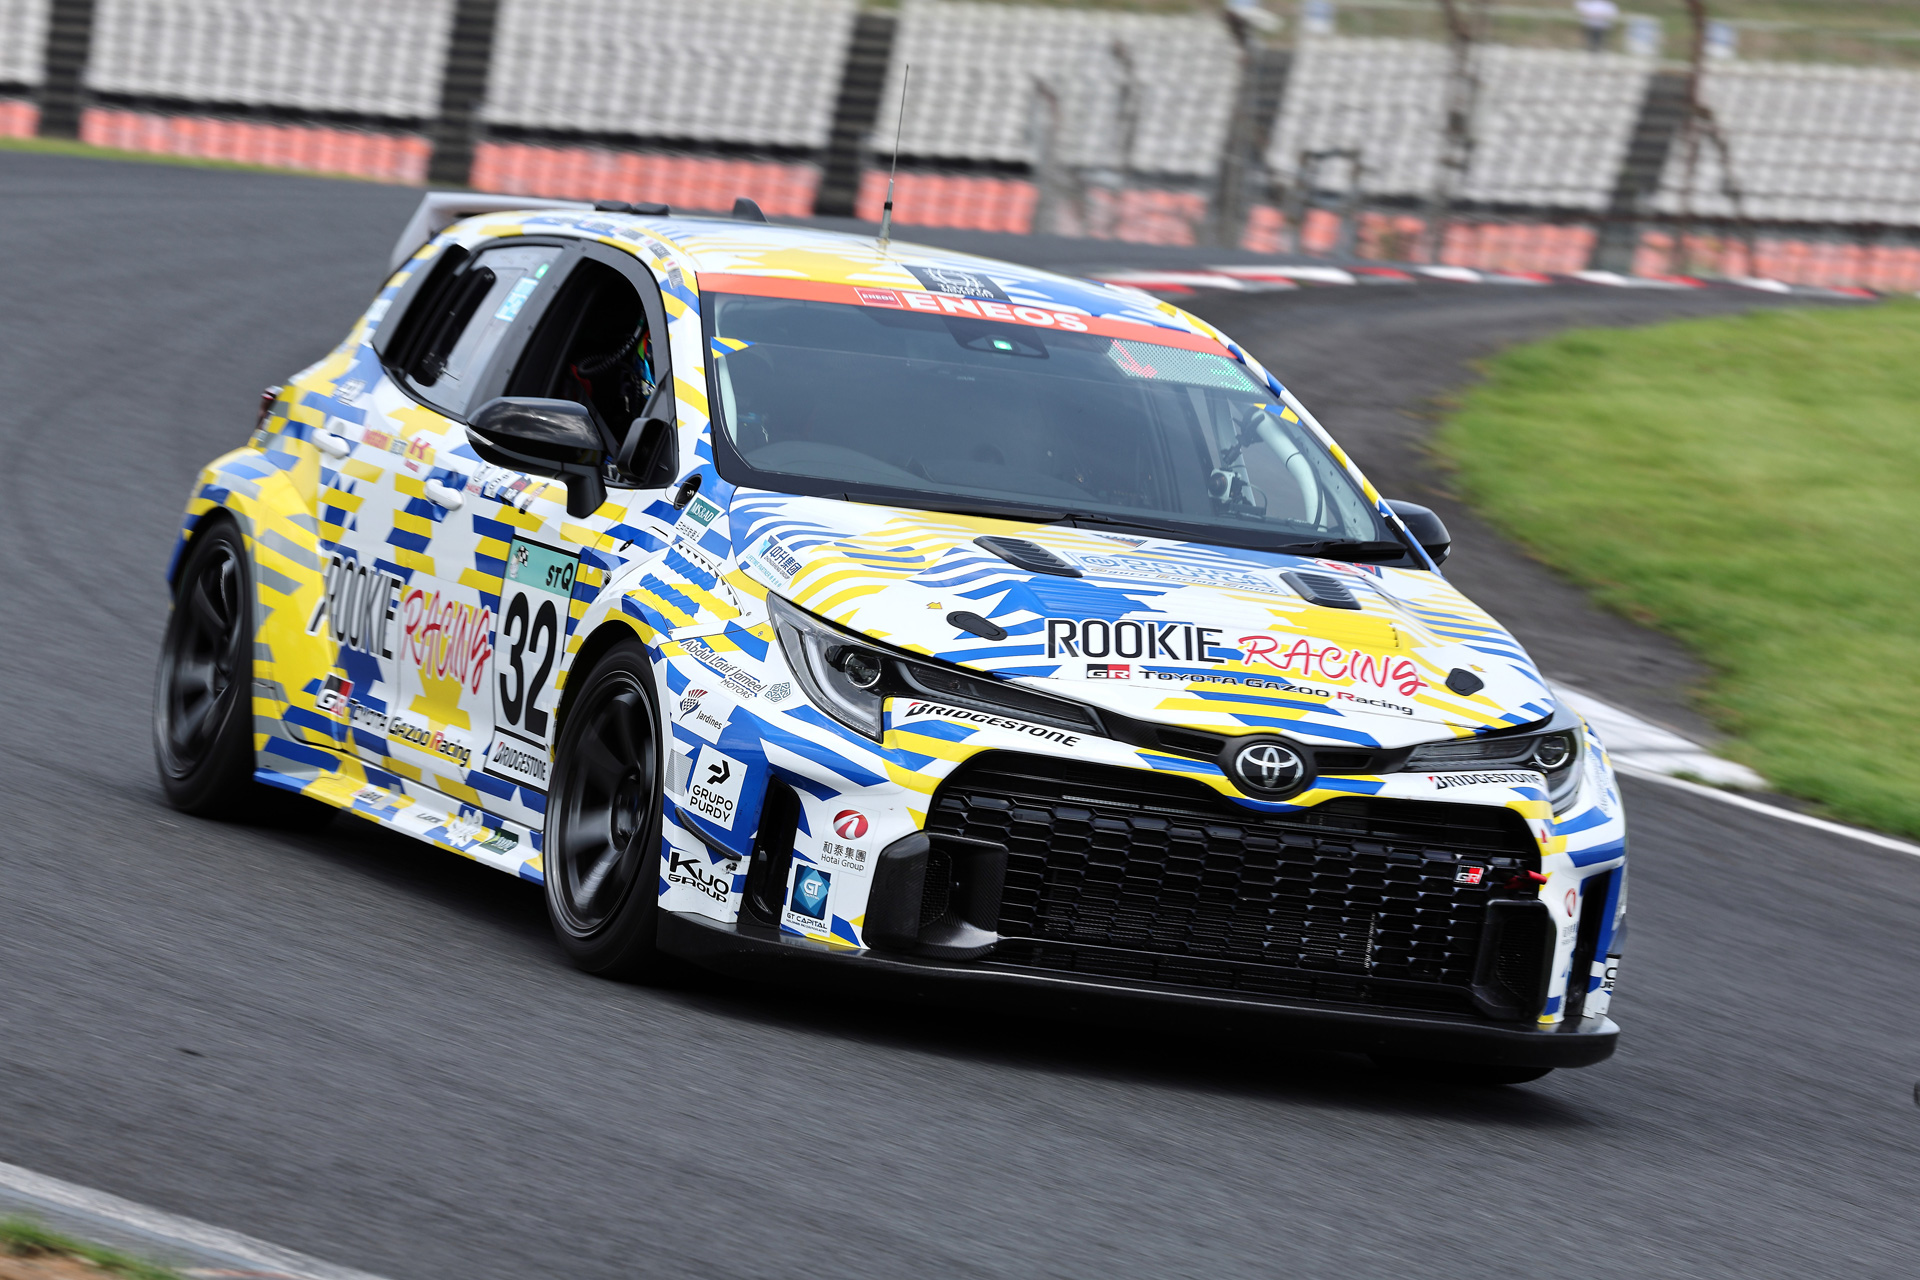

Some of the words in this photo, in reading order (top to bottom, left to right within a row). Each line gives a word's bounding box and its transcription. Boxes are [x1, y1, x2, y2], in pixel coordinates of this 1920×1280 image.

[862, 293, 894, 302] ENEOS
[901, 291, 1088, 332] ENEOS
[690, 501, 715, 522] MS&AD
[769, 546, 802, 576] 中升集团
[401, 589, 492, 695] RACING
[500, 592, 557, 738] 32
[681, 640, 711, 663] Abdul
[710, 654, 738, 674] Latif
[728, 668, 768, 692] Jameel
[1047, 619, 1226, 664] ROOKIE
[1238, 635, 1428, 696] RACING
[720, 678, 752, 699] MOTORS
[1087, 668, 1130, 679] GR
[1337, 691, 1413, 715] Racing
[696, 710, 723, 730] Jardines
[904, 701, 1081, 747] BRIDGESTONE
[429, 730, 472, 767] Racing
[492, 741, 546, 781] BRIDGESTONE
[1428, 773, 1545, 789] BRIDGESTONE
[689, 796, 731, 822] PURDY
[692, 784, 733, 811] GRUPO
[821, 853, 840, 866] Hotai
[841, 858, 865, 872] Group
[823, 841, 867, 862] 和泰集團
[668, 873, 727, 903] GROUP
[803, 878, 823, 896] GT
[1455, 869, 1483, 884] GR
[786, 912, 796, 921] GT
[796, 914, 828, 930] CAPITAL
